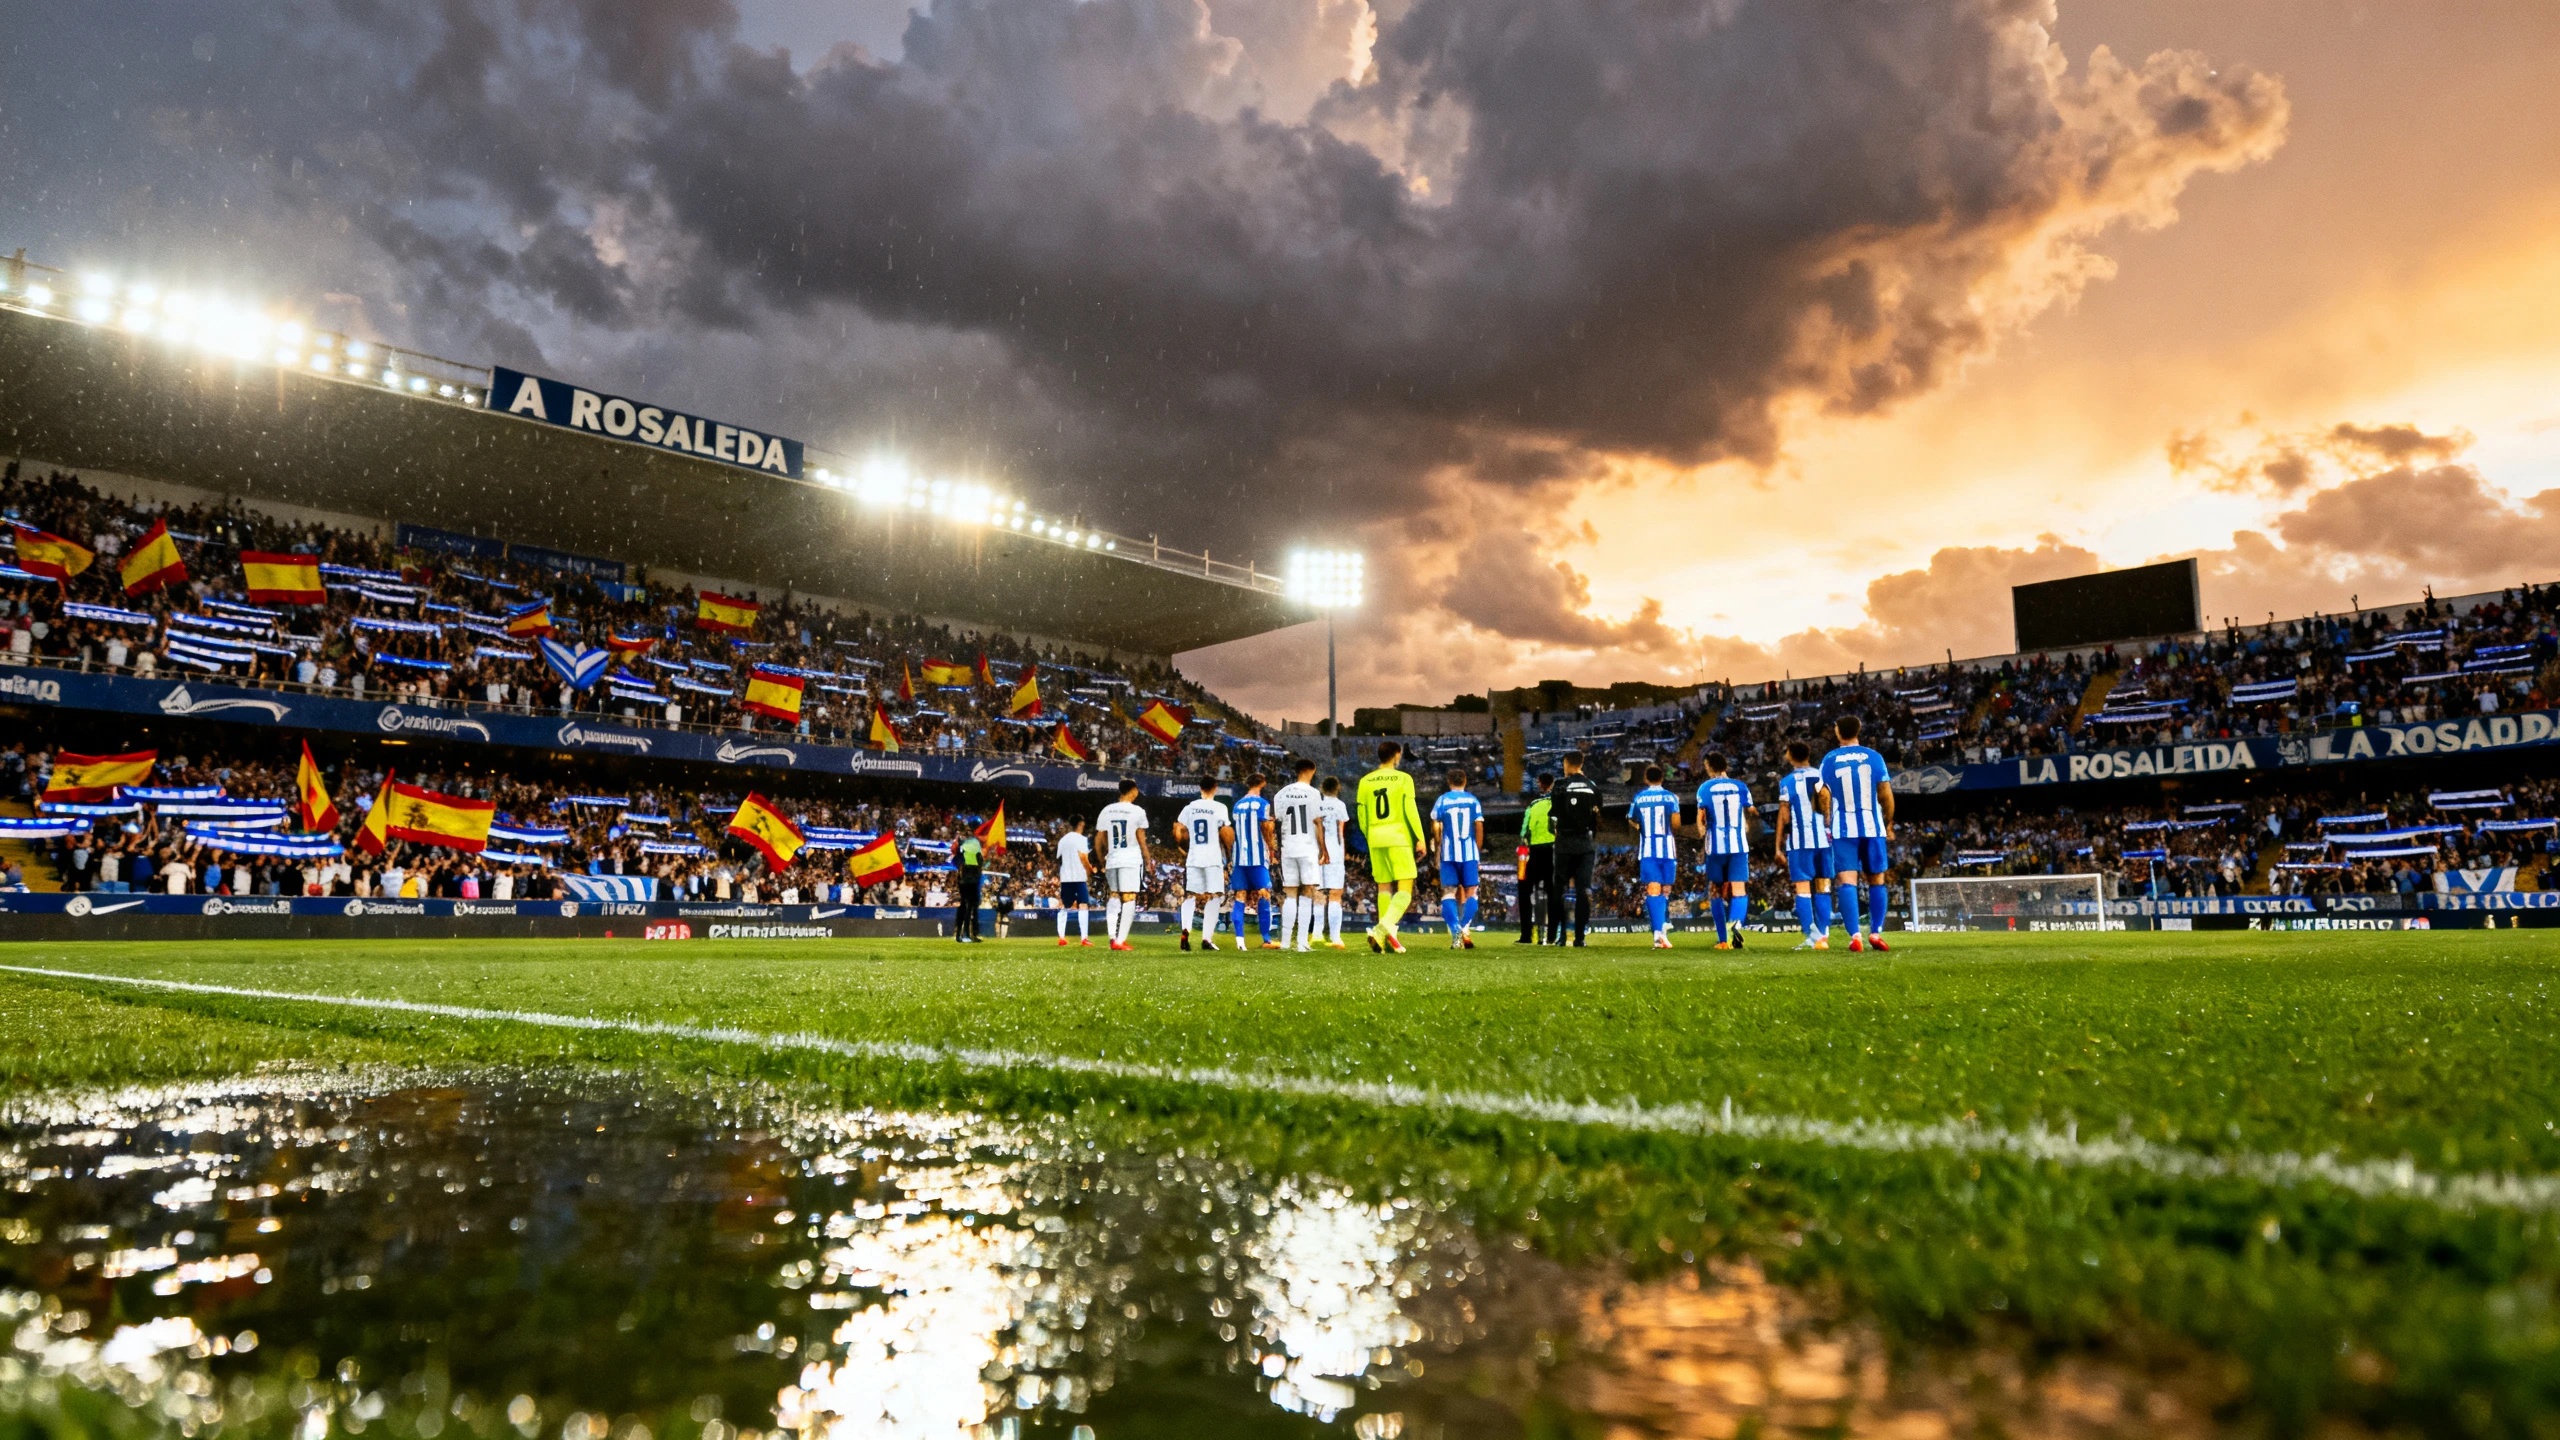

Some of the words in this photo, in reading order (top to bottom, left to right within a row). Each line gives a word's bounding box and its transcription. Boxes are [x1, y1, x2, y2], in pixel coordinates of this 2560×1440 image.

[509, 377, 547, 420] A
[570, 388, 788, 475] ROSALEDA
[2019, 758, 2059, 785] LA
[1835, 763, 1872, 813] 11
[1193, 819, 1209, 845] 8
[1286, 804, 1307, 835] 11
